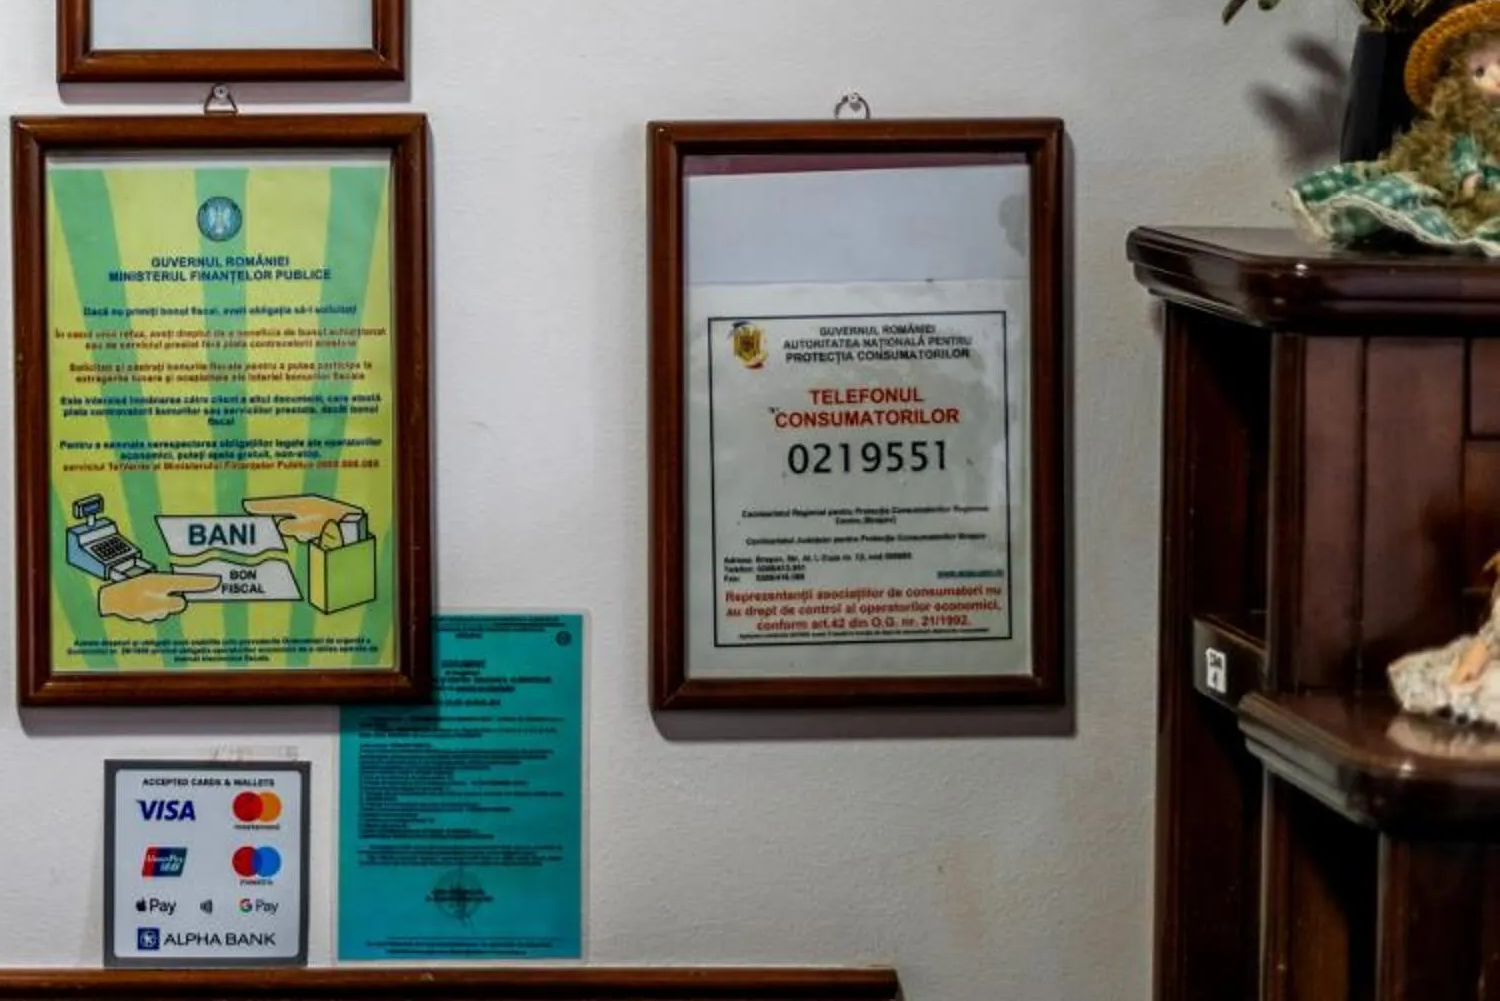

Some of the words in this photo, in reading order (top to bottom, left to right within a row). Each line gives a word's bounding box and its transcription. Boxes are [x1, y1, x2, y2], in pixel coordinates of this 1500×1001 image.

[151, 256, 223, 269] GUVERNUL
[226, 252, 290, 268] ROMÂNIEI
[108, 271, 187, 282] MINISTERUL
[275, 269, 332, 280] PUBLICE
[819, 326, 879, 337] GUVERNUL
[882, 323, 936, 335] ROMÂNIEI
[783, 338, 860, 350] AUTORITATEA
[927, 336, 972, 347] PENTRU
[857, 349, 971, 362] CONSUMATORILOR
[809, 387, 924, 405] TELEFONUL
[775, 408, 960, 429] CONSUMATORILOR
[787, 440, 947, 474] 0219551
[188, 523, 256, 546] BANI
[229, 569, 257, 580] BON
[221, 583, 266, 594] FISCAL
[887, 587, 902, 597] de
[905, 585, 983, 598] consumatori
[780, 605, 795, 615] de
[798, 603, 842, 615] control
[757, 619, 808, 631] conform
[142, 778, 189, 787] ACCEPTED
[191, 778, 221, 787] CARDS
[224, 779, 231, 787] &
[234, 778, 275, 787] WALLETS
[136, 799, 196, 821] VISA
[149, 898, 177, 916] Pay
[255, 899, 279, 915] Pay
[163, 932, 222, 946] ALPHA
[226, 932, 277, 946] BANK
